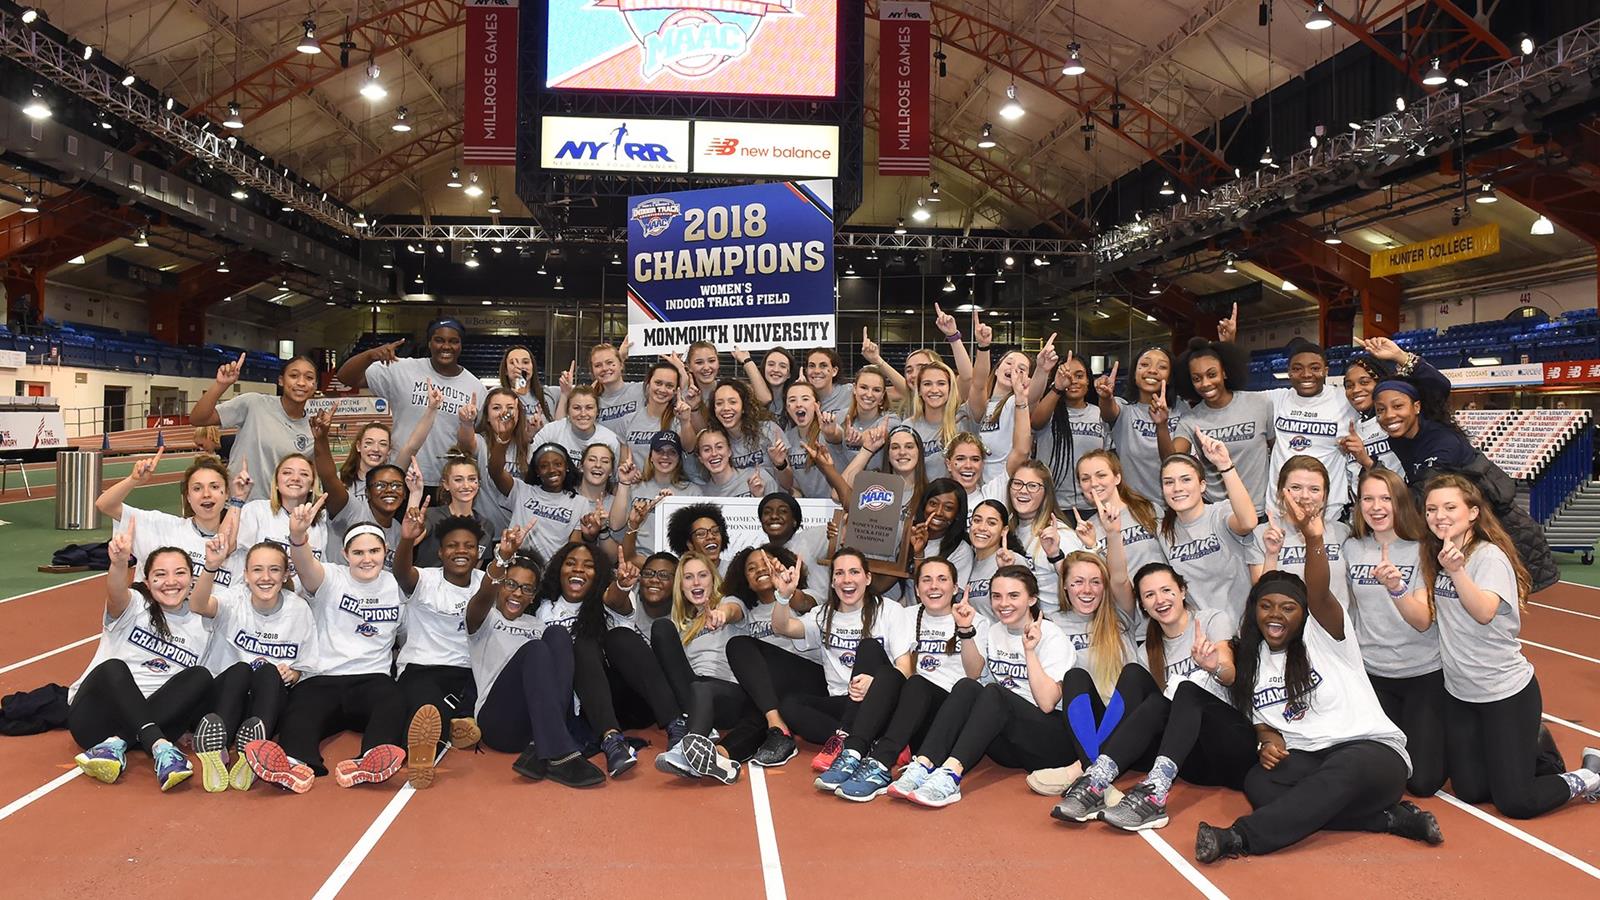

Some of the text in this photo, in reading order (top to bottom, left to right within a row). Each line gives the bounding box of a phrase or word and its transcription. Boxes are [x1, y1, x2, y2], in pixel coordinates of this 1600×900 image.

[484, 13, 498, 139] MILLROSE GAMES
[898, 26, 911, 150] MILLROSE GAMES
[741, 146, 770, 158] new
[773, 146, 831, 160] balance
[684, 203, 767, 242] 2018
[634, 240, 826, 283] CHAMPIONS
[1390, 236, 1474, 267] HUNTER COLLEGE
[700, 282, 753, 296] WOMEN'S
[665, 293, 790, 310] INDOOR TRACK & FIELD
[643, 321, 830, 347] MONMOUTH UNIVERSITY
[412, 394, 462, 415] UNIRSI
[600, 402, 637, 418] AWKS
[627, 431, 656, 442] HAW
[1200, 422, 1255, 440] AWKS
[524, 498, 573, 520] HAWKS
[861, 491, 892, 506] MAAC
[341, 597, 398, 621] CHAPIONS
[130, 630, 197, 668] CHAMPIONS
